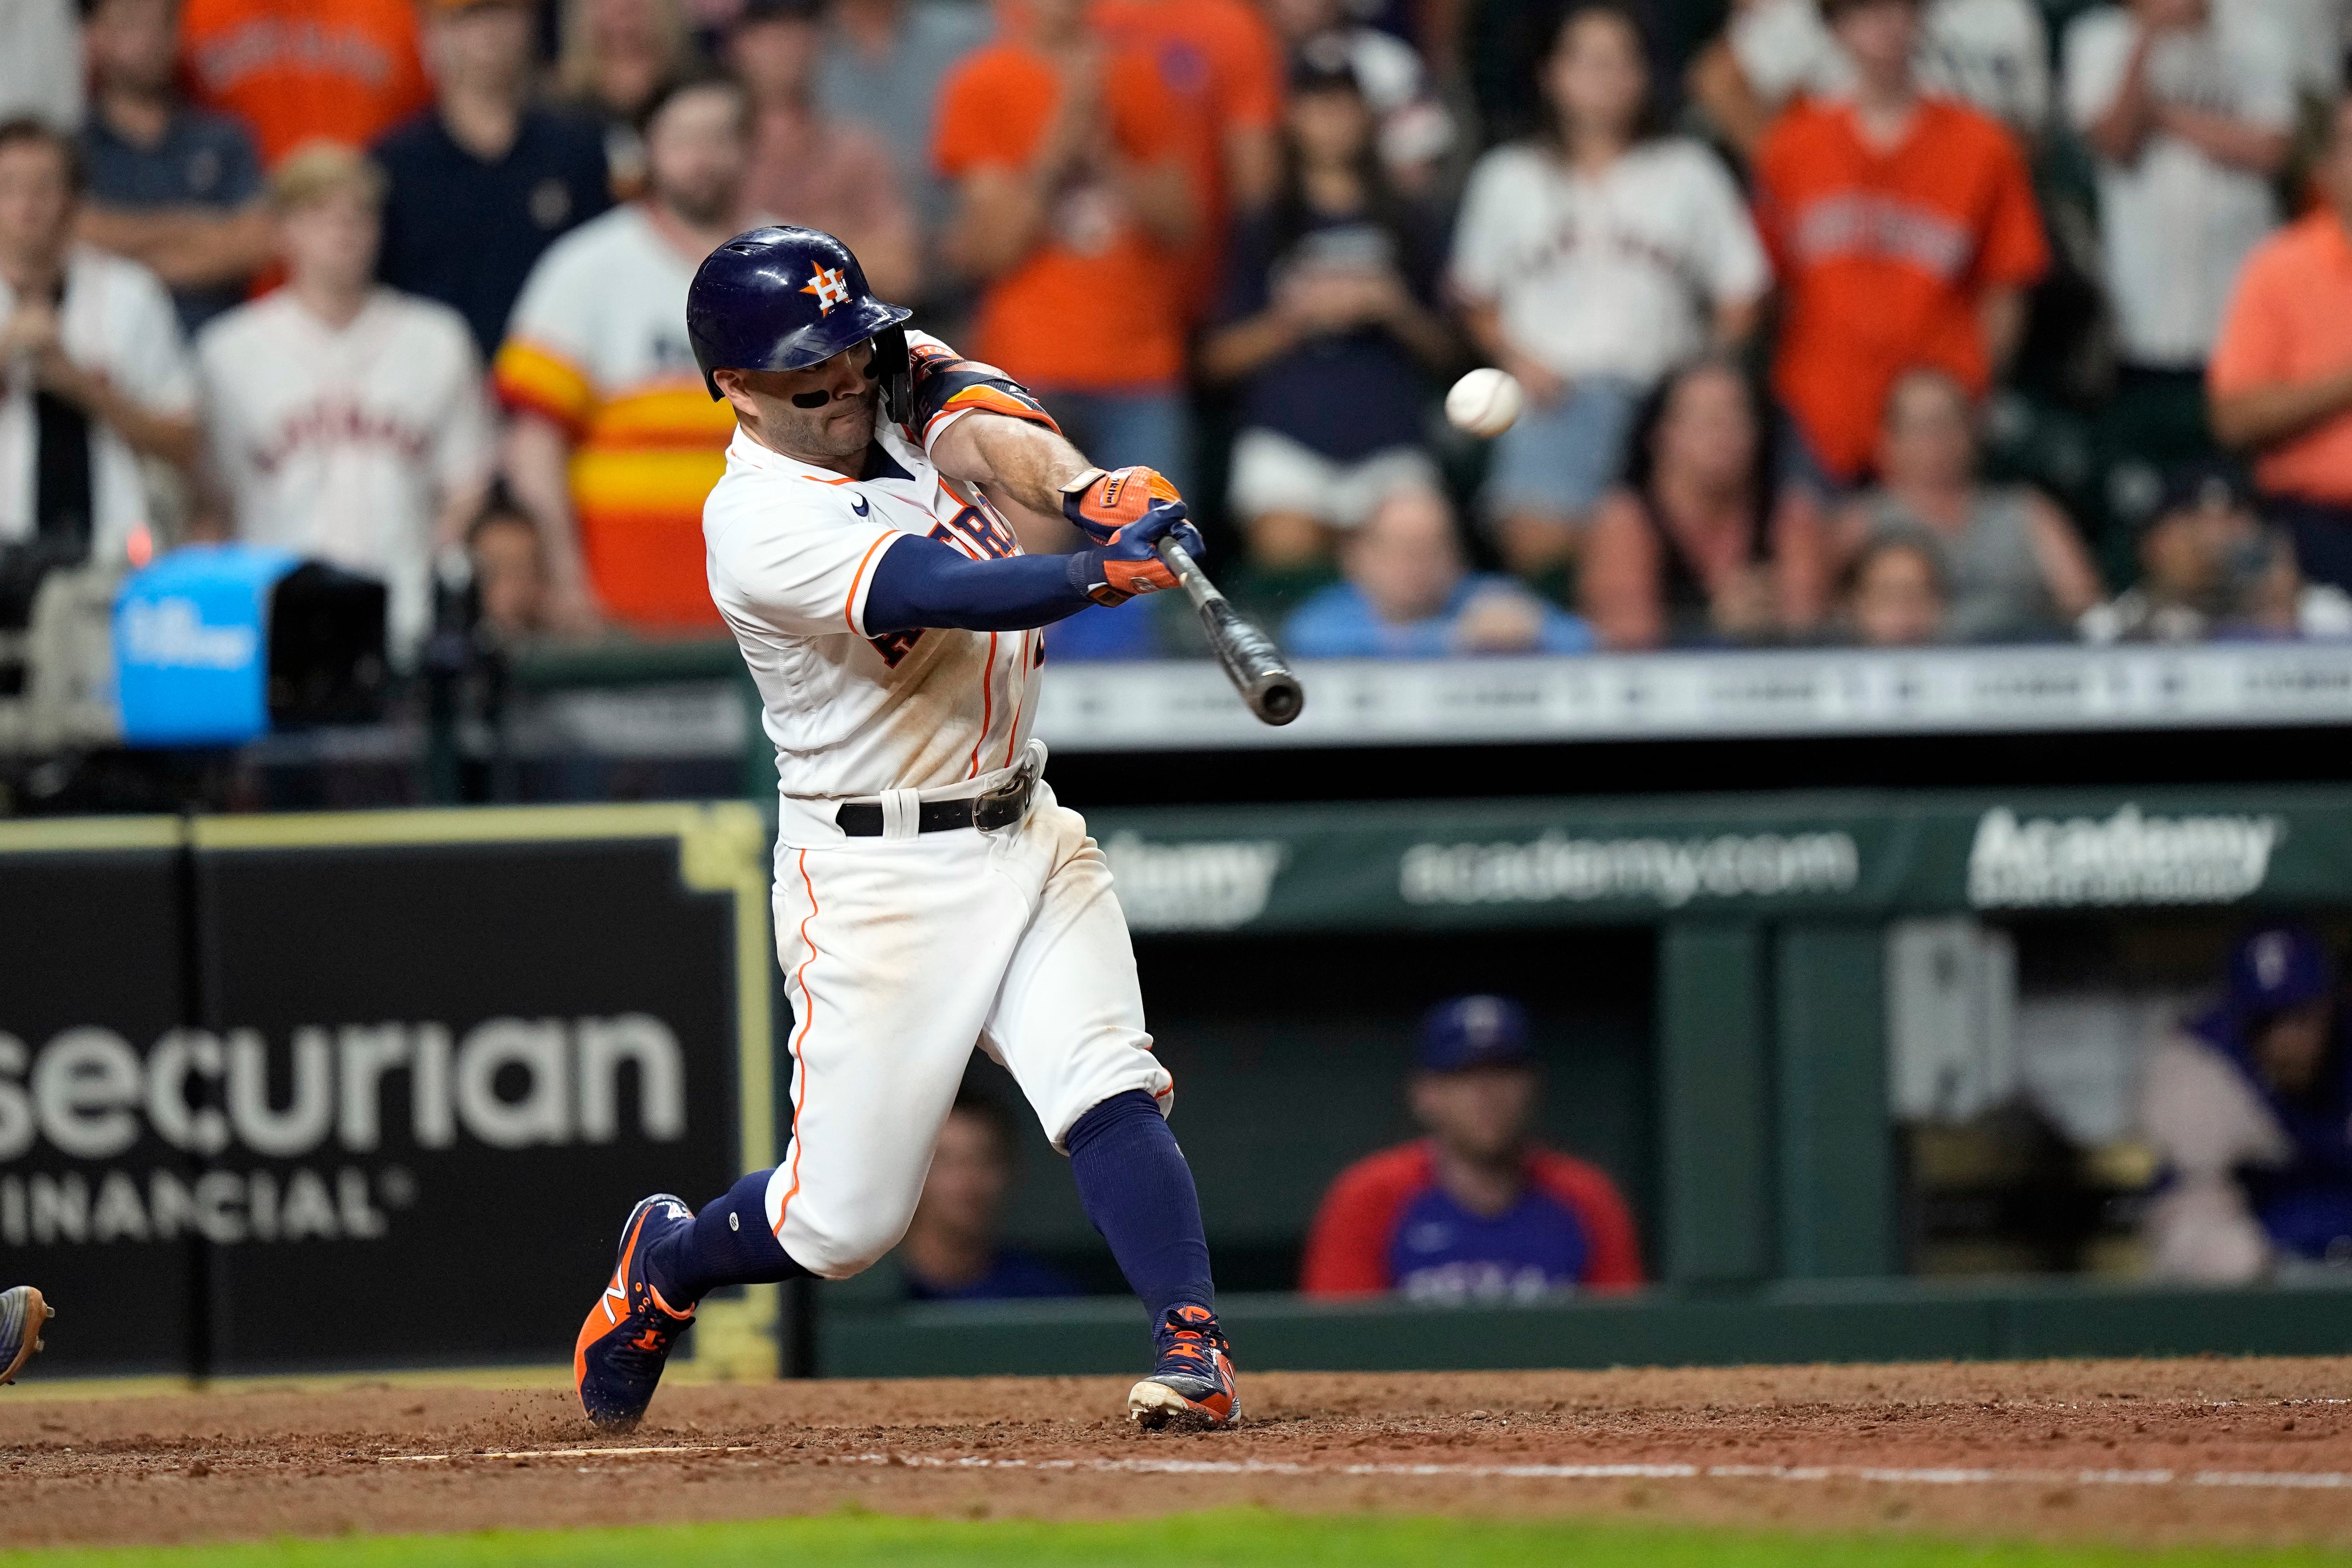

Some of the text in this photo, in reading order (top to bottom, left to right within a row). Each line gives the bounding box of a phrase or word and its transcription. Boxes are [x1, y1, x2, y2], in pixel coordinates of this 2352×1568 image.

[808, 267, 848, 310] H
[910, 346, 952, 368] USTON
[1106, 831, 1283, 915] demy
[1401, 831, 1859, 907] academy.com
[1, 1166, 389, 1244] INANCIAL
